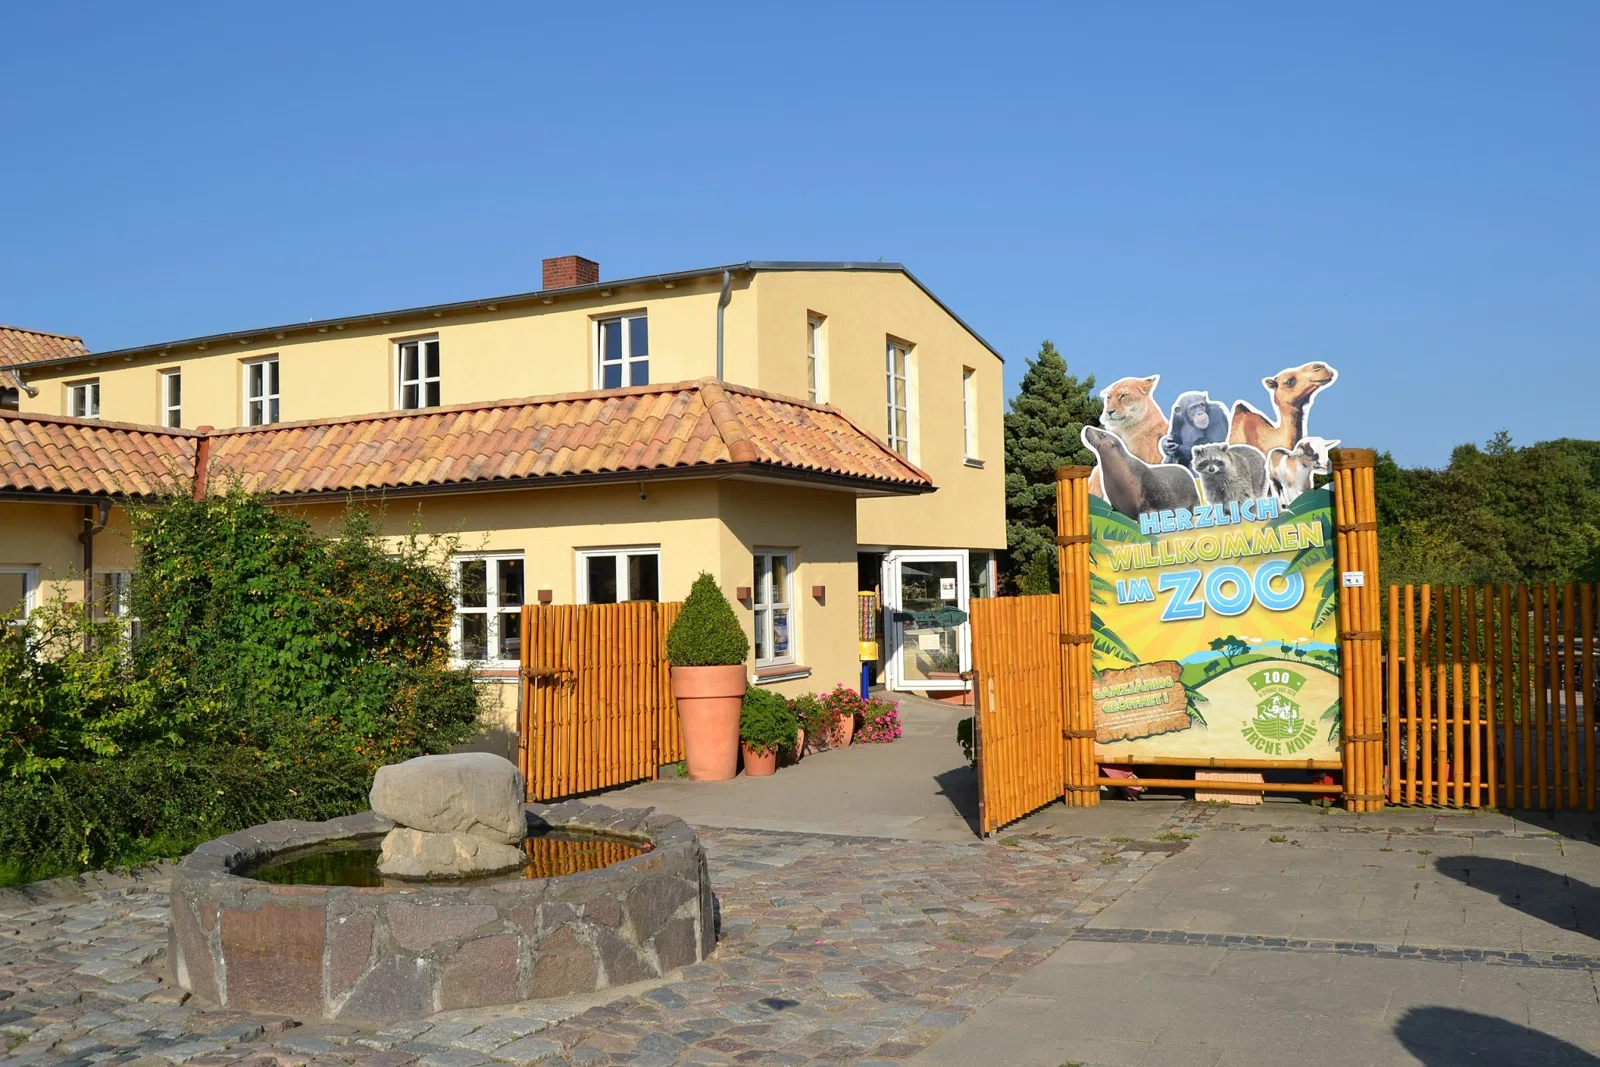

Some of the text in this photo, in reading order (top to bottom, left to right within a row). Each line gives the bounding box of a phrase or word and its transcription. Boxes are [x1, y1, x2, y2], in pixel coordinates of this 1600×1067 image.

[1139, 497, 1278, 535] HERZLICH
[1108, 521, 1325, 571] WILLKOMMEN
[1116, 560, 1305, 622] IM ZOO
[1093, 675, 1175, 700] GANZJÄHRIG
[1263, 671, 1290, 684] ZOO
[1241, 724, 1318, 756] ARCHE NOAH
